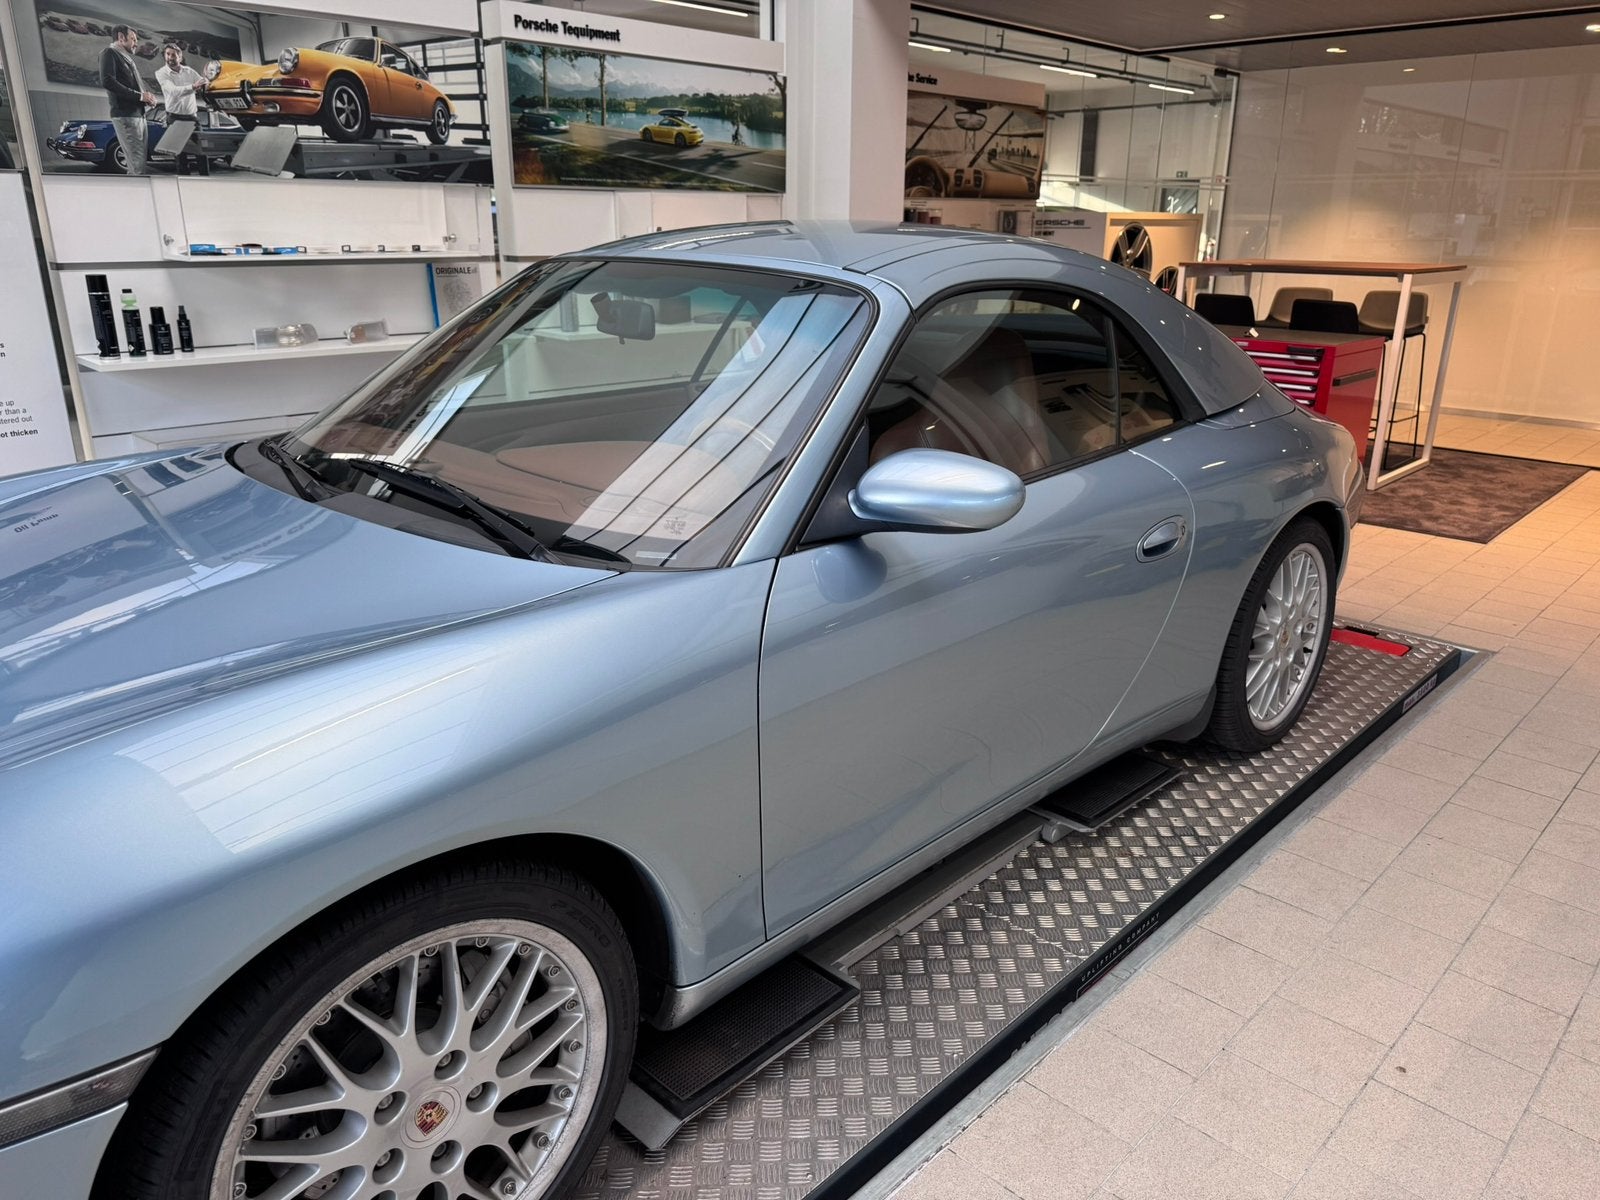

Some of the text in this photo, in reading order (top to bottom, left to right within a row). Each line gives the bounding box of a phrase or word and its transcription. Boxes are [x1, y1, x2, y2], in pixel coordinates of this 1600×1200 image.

[513, 14, 621, 41] Porsche Tequipment
[435, 266, 472, 275] ORIGINALE
[10, 428, 39, 437] thicken
[1081, 911, 1160, 982] UPLIFTING COMPANY
